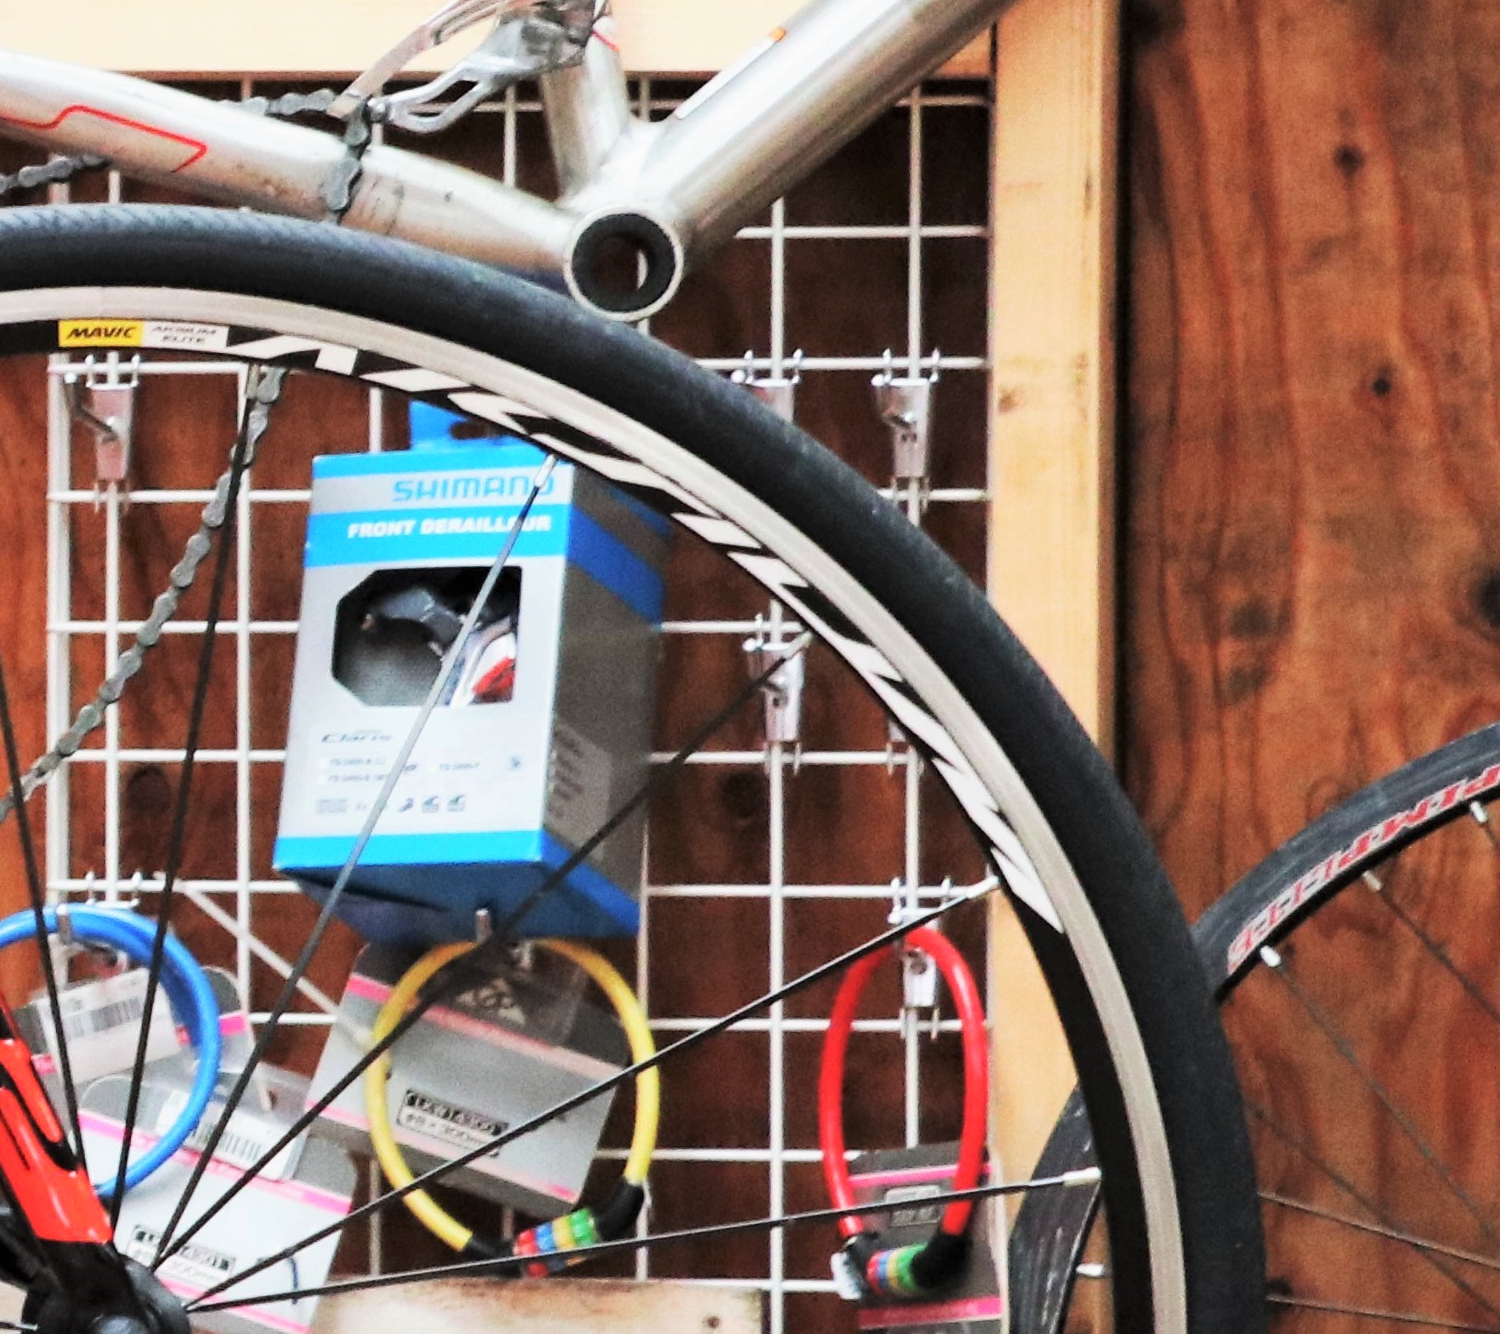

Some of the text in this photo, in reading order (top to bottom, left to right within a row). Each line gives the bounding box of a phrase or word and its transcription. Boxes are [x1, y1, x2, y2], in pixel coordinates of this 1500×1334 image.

[66, 325, 136, 340] MAVIC
[392, 475, 554, 503] SHIMANO
[348, 519, 414, 539] FRONT
